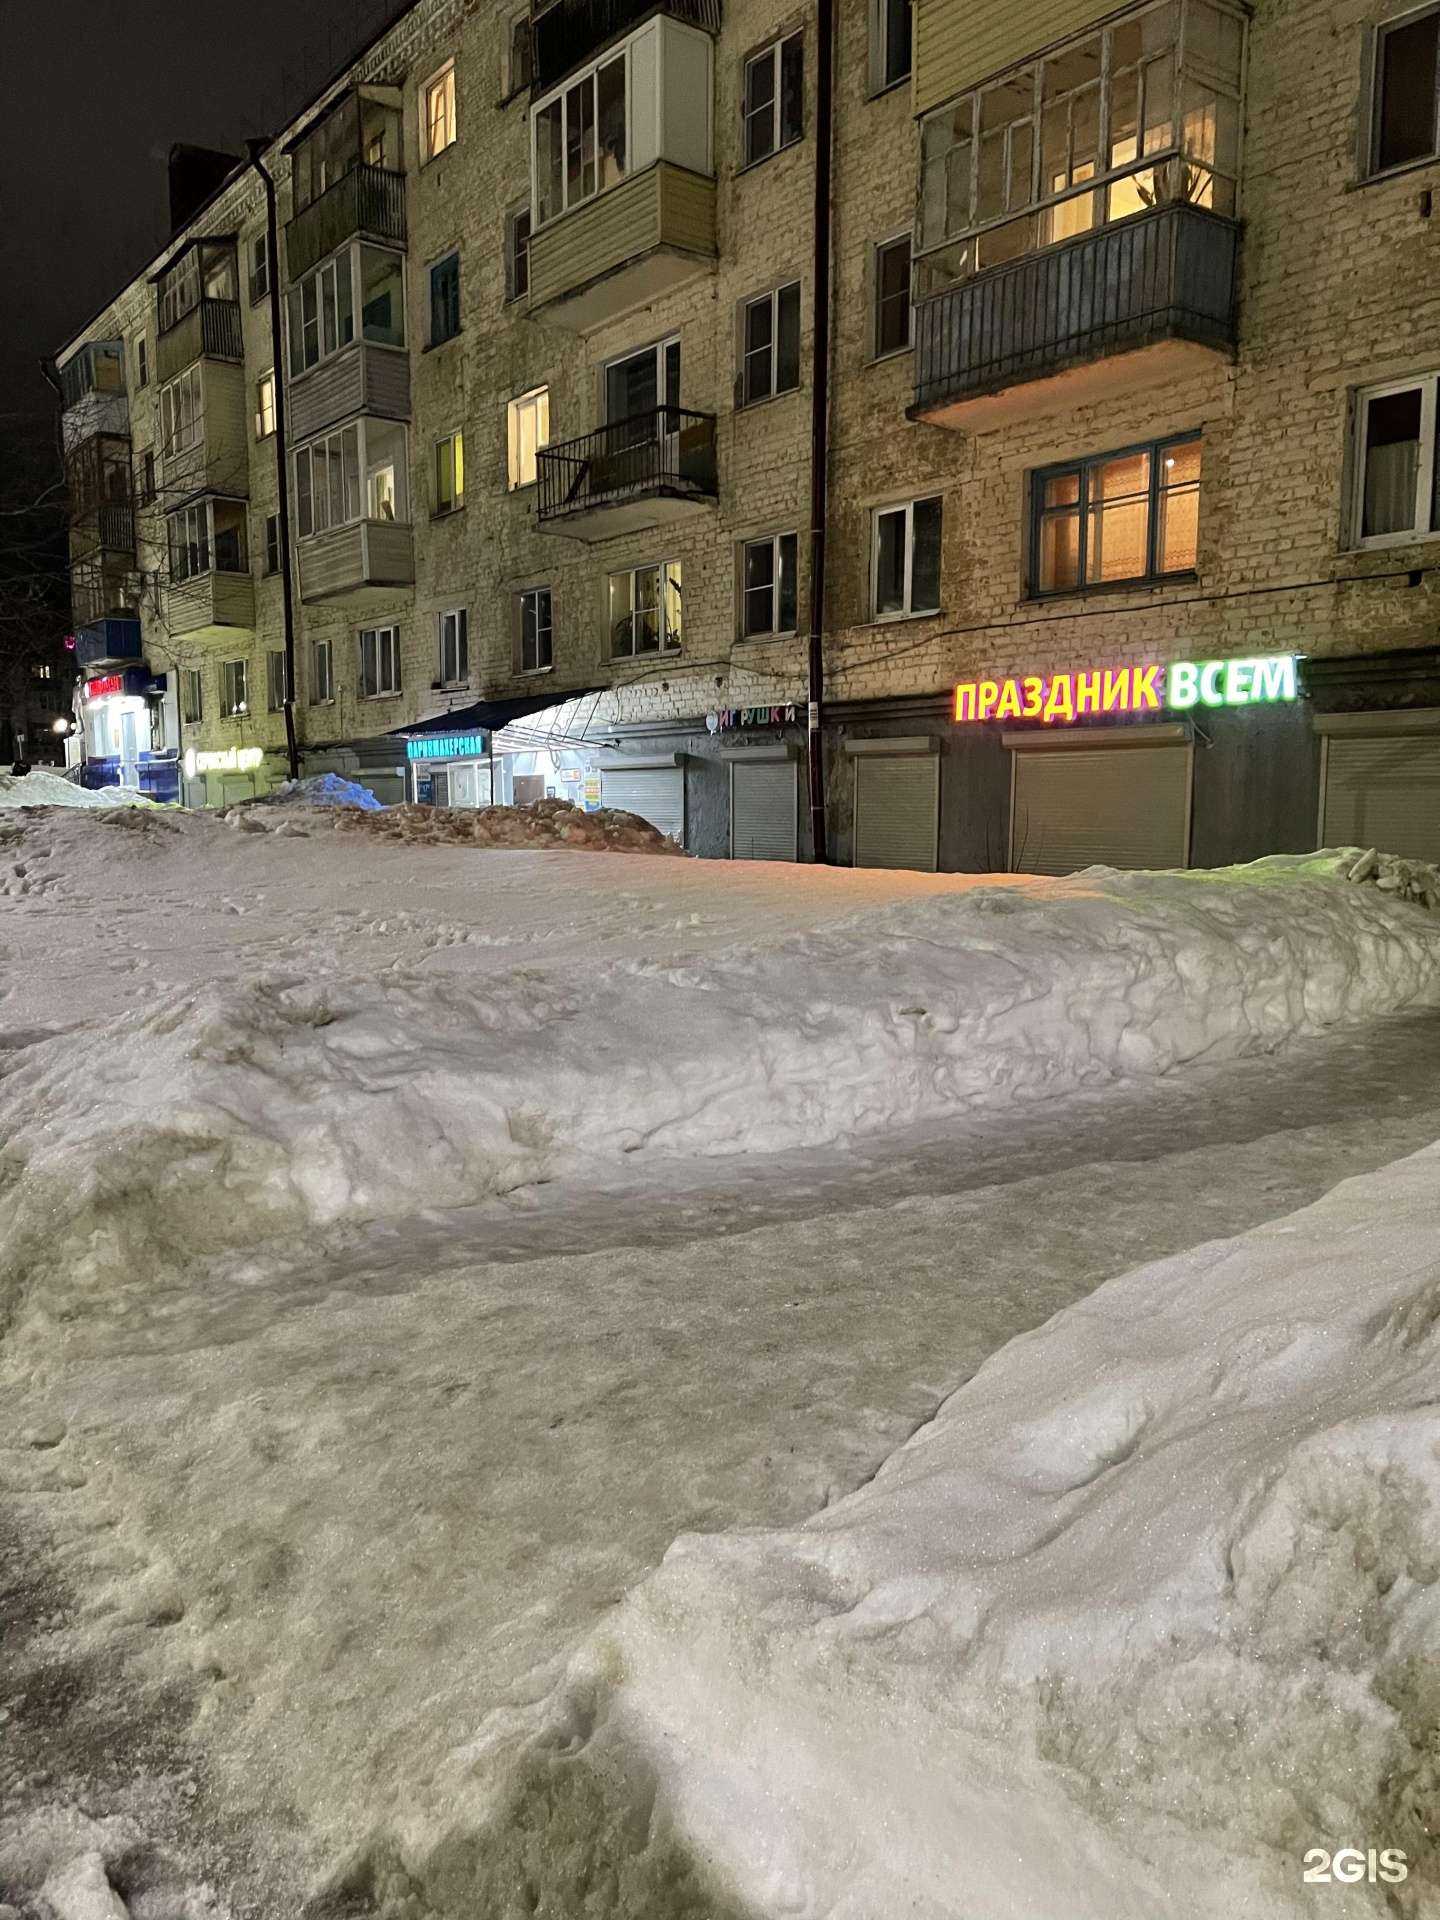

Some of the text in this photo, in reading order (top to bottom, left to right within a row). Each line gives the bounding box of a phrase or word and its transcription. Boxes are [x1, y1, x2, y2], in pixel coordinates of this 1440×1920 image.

[954, 655, 1298, 723] ПРАЗДНИК ВСЕМ
[407, 735, 482, 759] ПАРИКМАХЕРСКАЯ
